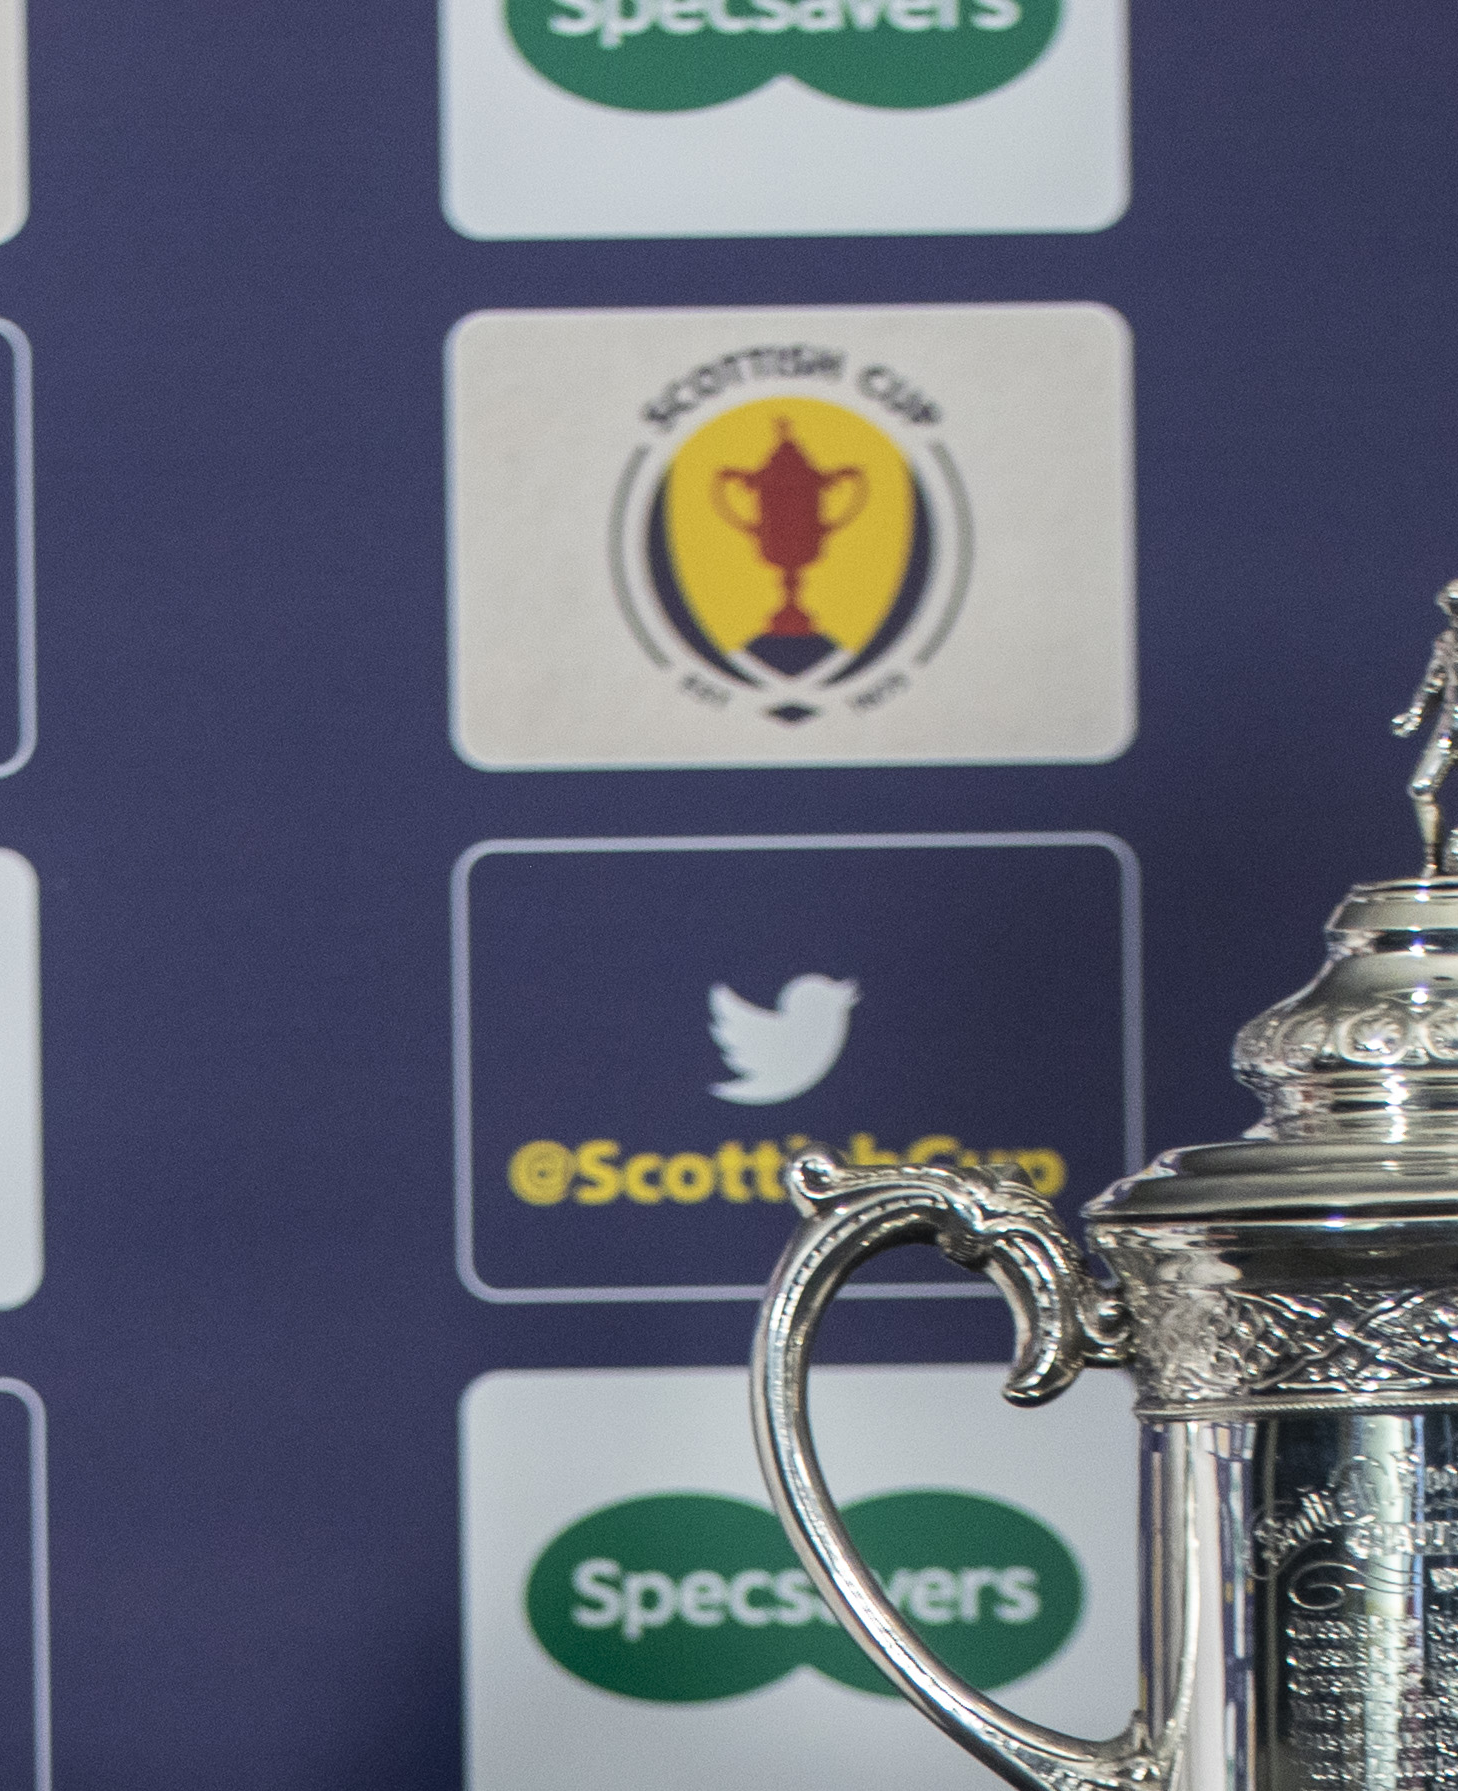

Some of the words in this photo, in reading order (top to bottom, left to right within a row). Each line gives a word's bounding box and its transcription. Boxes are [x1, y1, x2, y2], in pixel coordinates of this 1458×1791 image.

[641, 342, 847, 434] SCOTTISH
[854, 362, 943, 427] CUP
[572, 1556, 1041, 1641] Specsvers
